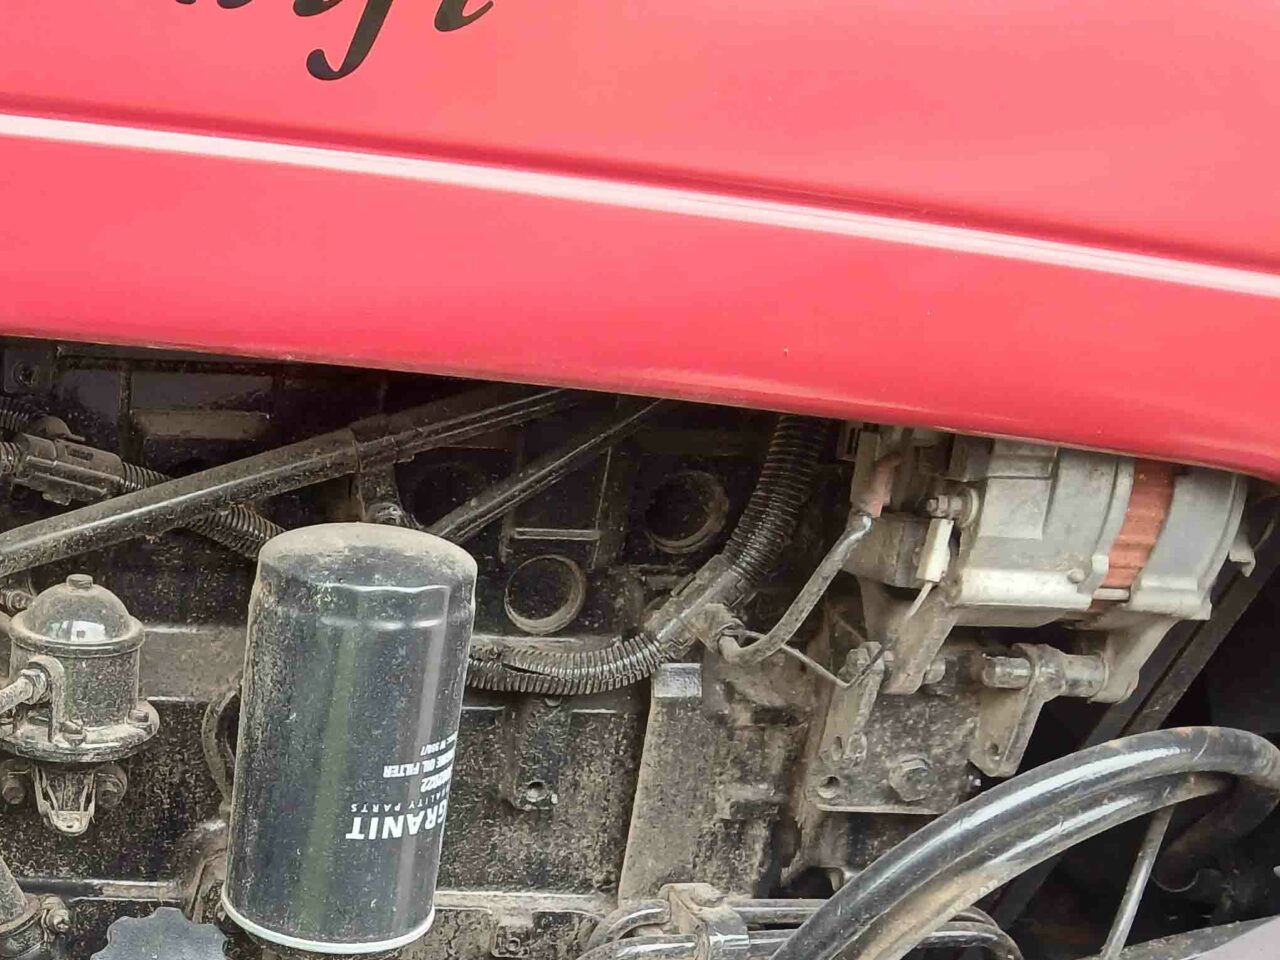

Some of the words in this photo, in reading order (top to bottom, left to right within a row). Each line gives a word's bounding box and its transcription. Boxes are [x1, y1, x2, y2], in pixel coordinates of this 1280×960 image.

[383, 762, 420, 778] FILTER
[350, 802, 402, 813] PARTS
[345, 798, 448, 840] GRANIT
